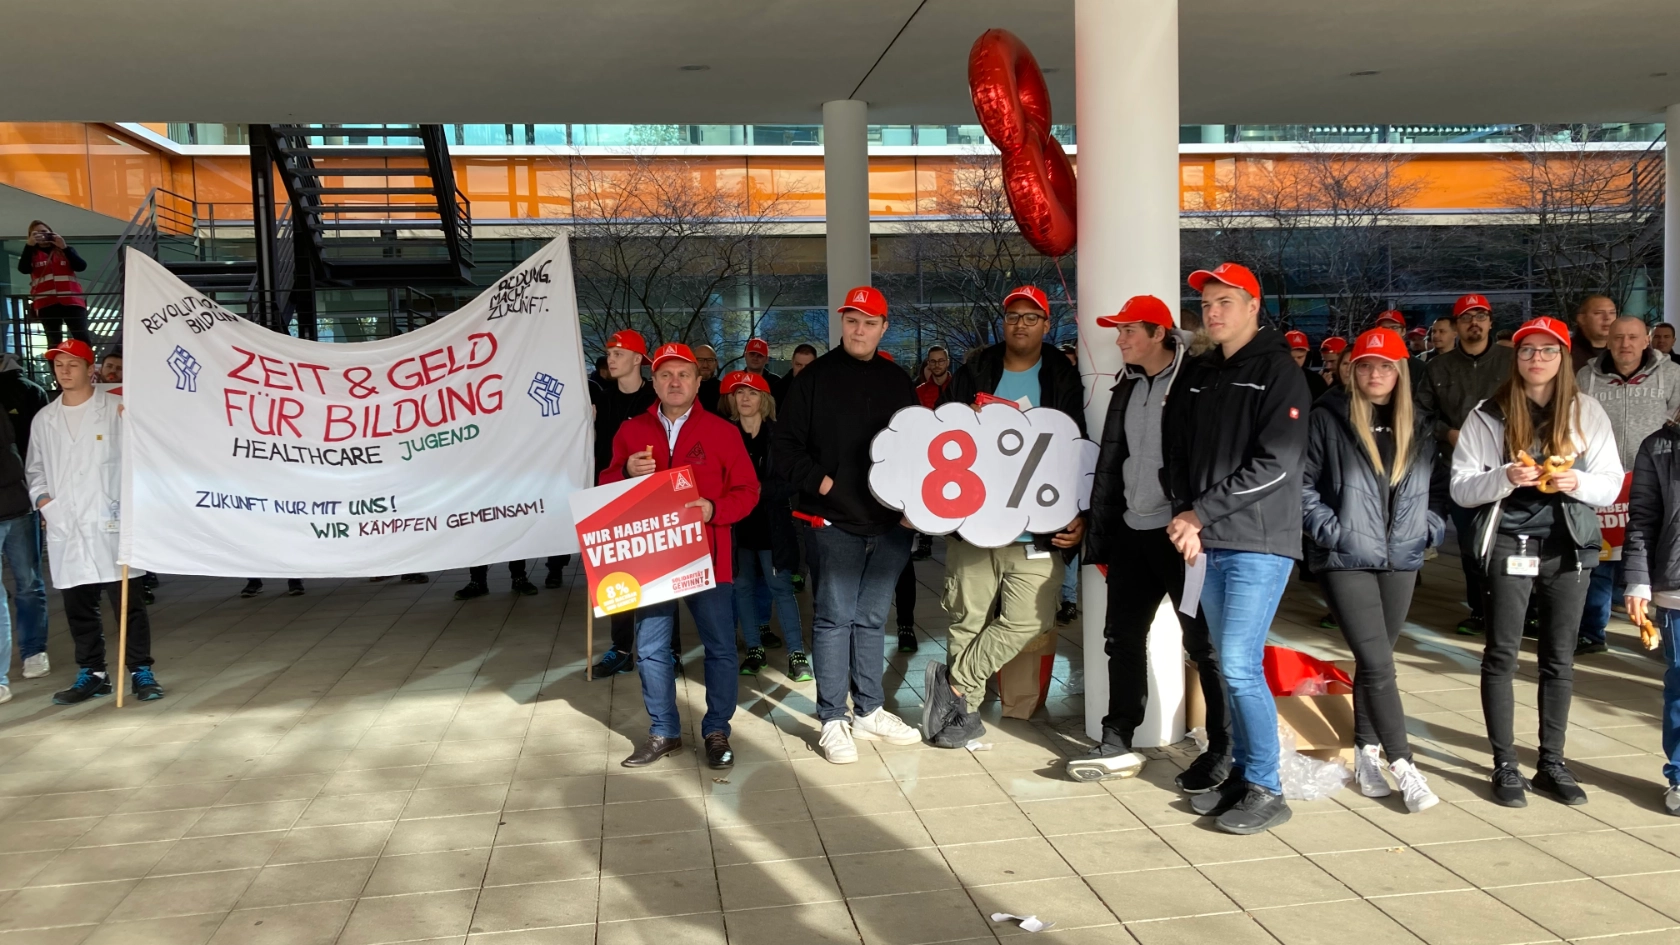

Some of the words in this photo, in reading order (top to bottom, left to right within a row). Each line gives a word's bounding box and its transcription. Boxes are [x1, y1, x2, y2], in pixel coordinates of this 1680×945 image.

[141, 296, 218, 334] REVOLUTIO
[186, 311, 239, 334] BILDUN
[487, 296, 549, 321] ZUKUNFT.
[227, 345, 330, 395] ZEIT
[343, 366, 380, 399] &
[387, 332, 498, 390] GELD
[224, 388, 304, 438] FÜR
[323, 374, 503, 442] BILDUNG
[232, 437, 383, 466] HEALTHCARE
[398, 423, 480, 461] JUGEND
[921, 429, 1060, 519] 8%
[195, 490, 268, 512] ZUKUNFT
[274, 499, 309, 515] NUR
[311, 500, 342, 515] MIT
[349, 495, 397, 516] UNS!
[310, 522, 350, 539] WIR
[359, 515, 437, 537] KÄMPFEN
[446, 498, 545, 529] GEMEINSAM!
[582, 528, 611, 547] WIR
[613, 516, 660, 539] HABEN
[662, 512, 680, 529] ES
[586, 521, 703, 568] VERDIENT!
